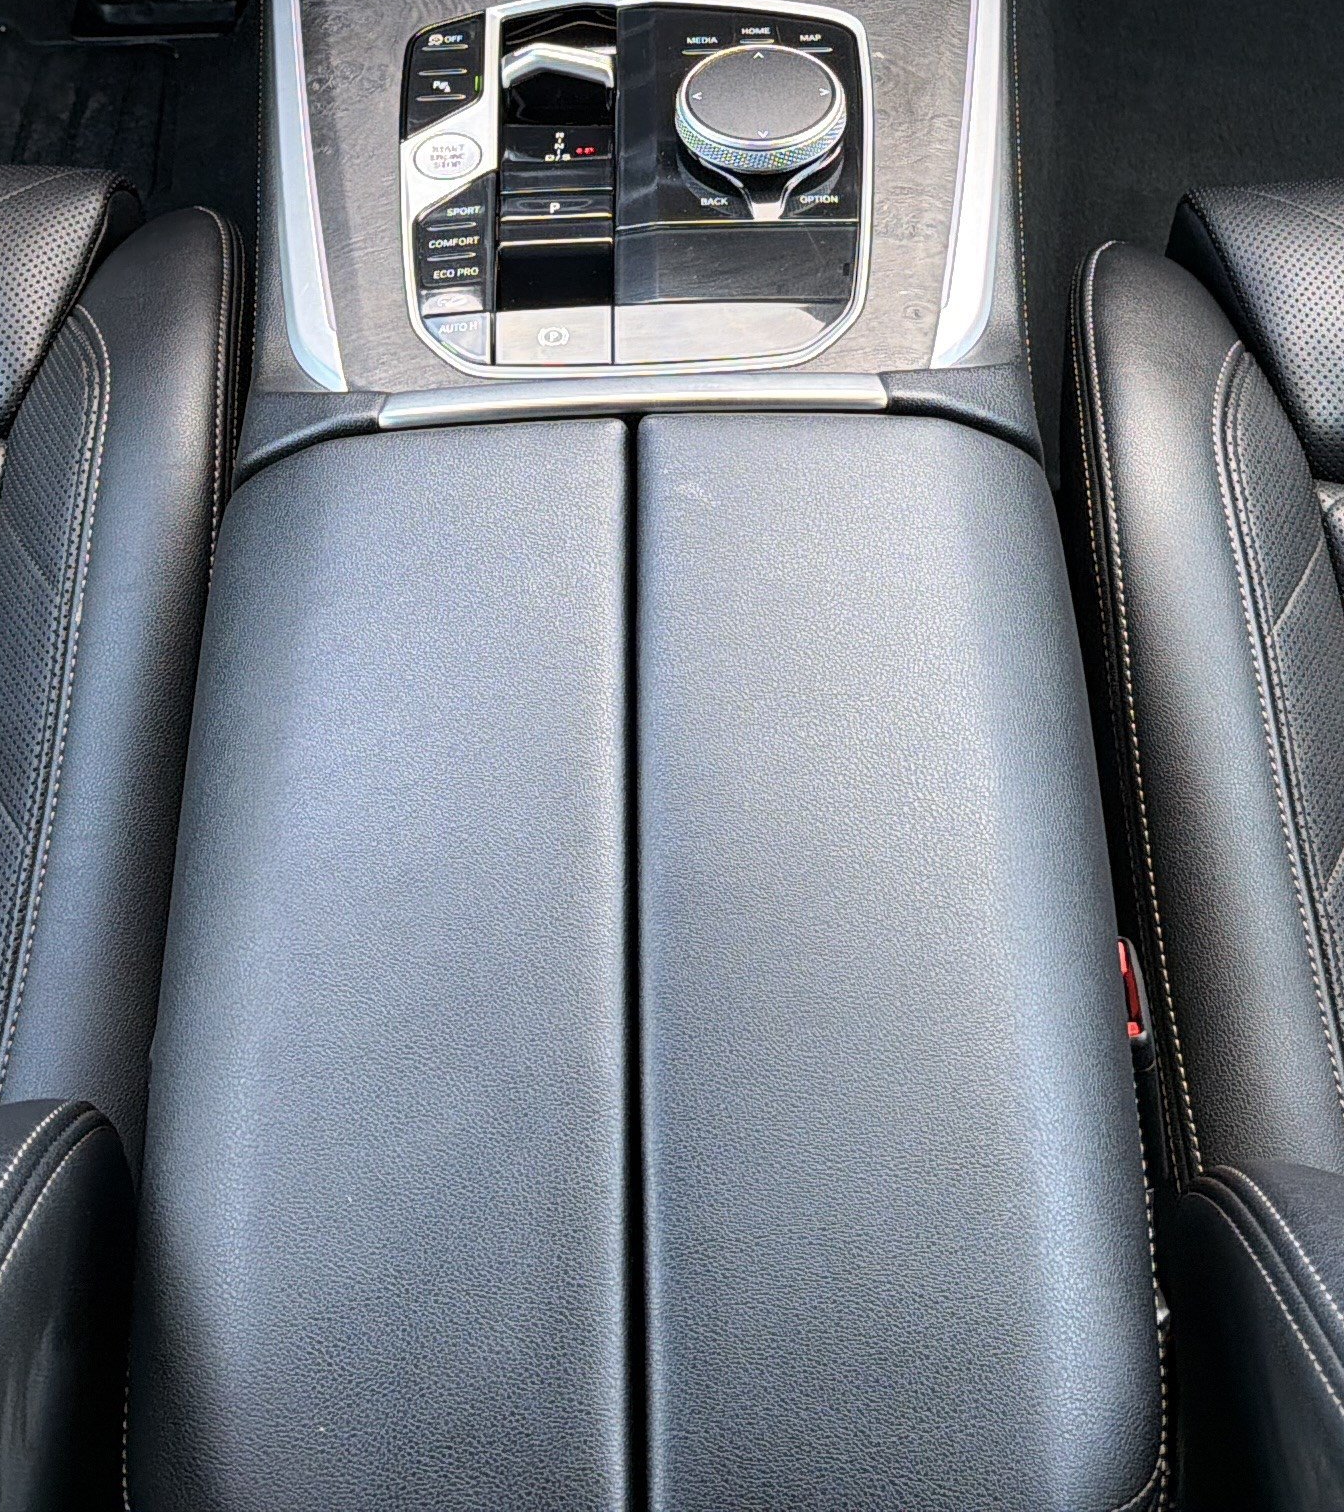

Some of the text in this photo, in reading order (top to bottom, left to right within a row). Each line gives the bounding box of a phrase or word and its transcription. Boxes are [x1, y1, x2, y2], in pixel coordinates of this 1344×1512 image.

[741, 27, 771, 35] HOME
[444, 35, 463, 43] OFF
[686, 37, 718, 45] MEDIA
[799, 34, 822, 42] MAP
[701, 197, 728, 206] BACK
[799, 195, 839, 204] OPTION
[447, 206, 481, 216] SPORT
[549, 202, 560, 214] P
[428, 236, 480, 249] COMFORT
[433, 267, 479, 279] ECO PRO
[438, 321, 480, 334] AUTO H
